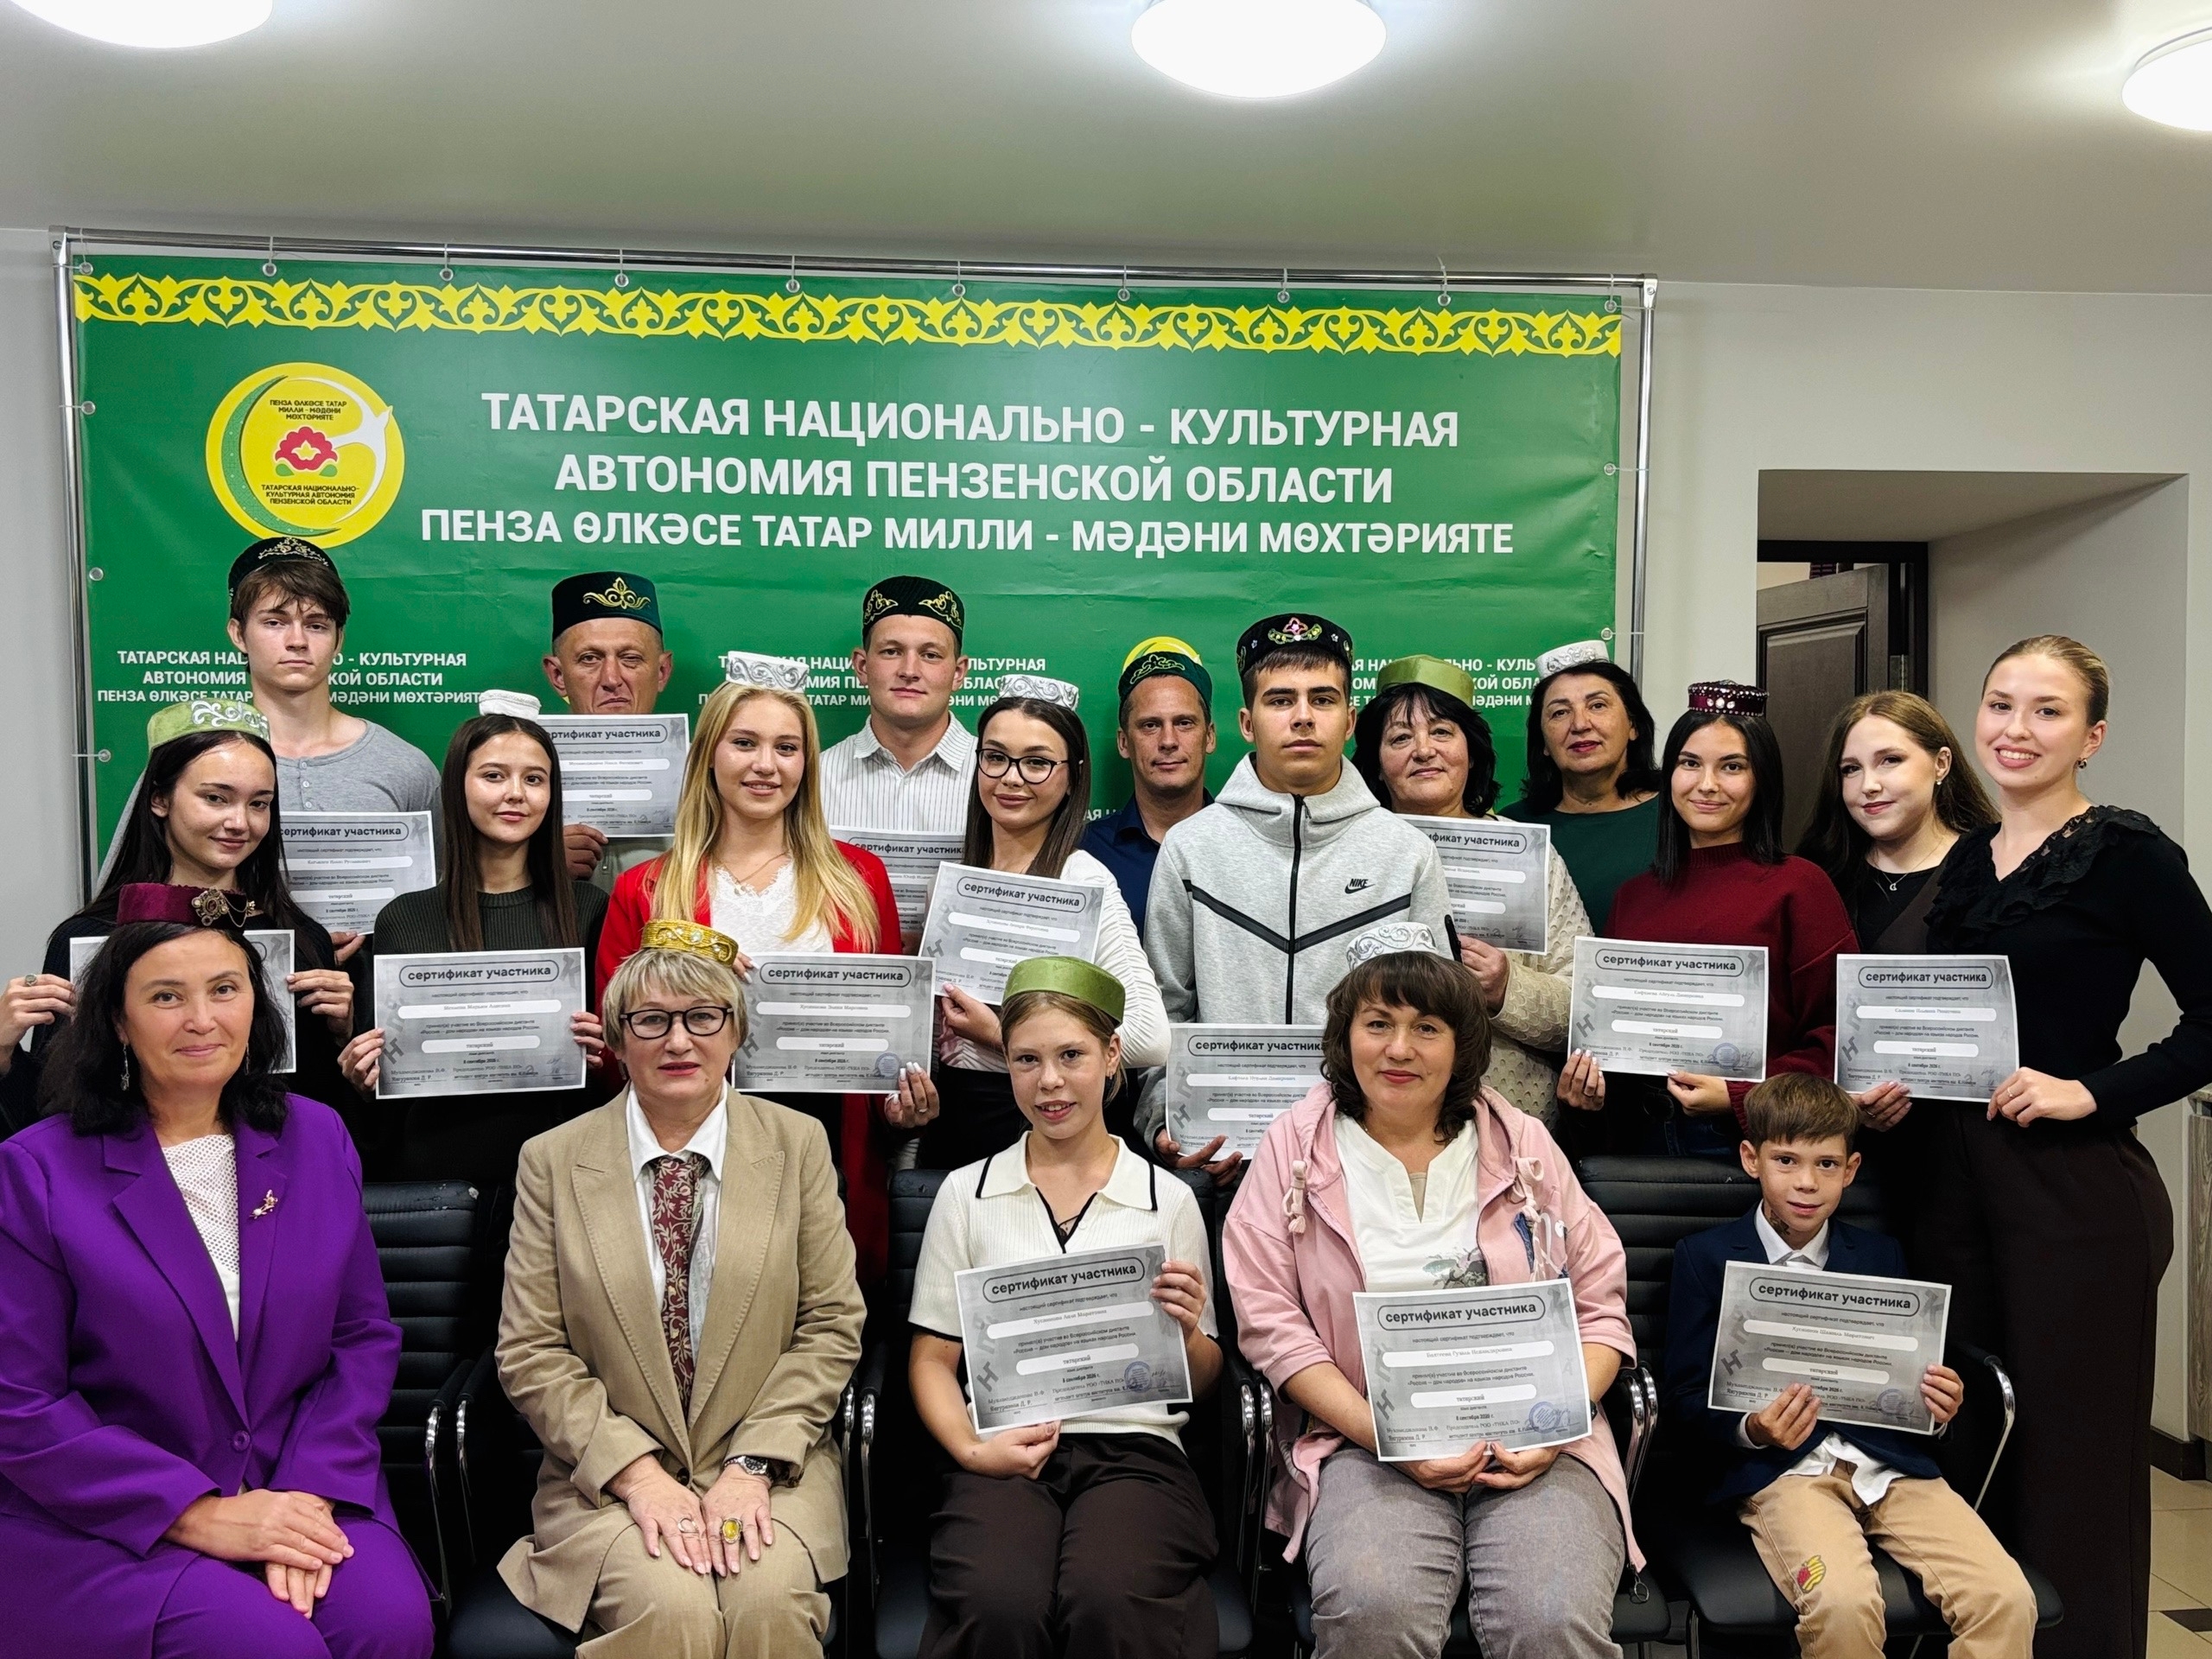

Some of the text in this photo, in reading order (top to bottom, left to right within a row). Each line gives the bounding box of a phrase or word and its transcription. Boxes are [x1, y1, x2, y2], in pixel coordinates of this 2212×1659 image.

[481, 392, 1458, 447] ТАТАРСКАЯ НАЦИОНАЛЬНО - КУЛЬТУРНАЯ
[554, 454, 1393, 504] АВТОНОМИЯ ПЕНЗЕНСКОЙ ОБЛАСТИ
[422, 508, 563, 543] ПЕНЗА
[574, 511, 741, 546] ӨЛКӘСЕ
[752, 514, 873, 549] ТАТАР
[885, 518, 1033, 550] МИЛЛИ
[1072, 520, 1249, 559] МӘДӘНИ
[1260, 521, 1514, 555] МӨХТӘРИЯТЕ
[118, 651, 211, 664] ТАТАРСКАЯ
[359, 653, 467, 666] КУЛЬТУРНАЯ
[968, 658, 1046, 671] ЛЬТУРНАЯ
[143, 671, 246, 684] АВТОНОМИЯ
[365, 672, 442, 686] ОБЛАСТИ
[958, 677, 1001, 690] БЛАС
[1502, 677, 1540, 690] ОБЛА
[98, 690, 146, 702] ПЕНЗА
[394, 692, 482, 703] МӨХТӘРИЯТ
[809, 695, 847, 705] ТАТАР
[1472, 695, 1524, 708] ӘДӘНИ
[547, 729, 660, 740] ртификат участника
[344, 827, 401, 837] участника
[1427, 832, 1520, 847] ификат участника
[1350, 878, 1369, 887] NIKE
[964, 882, 1080, 906] сертификат участника
[1603, 955, 1736, 970] сертификат участника
[408, 966, 551, 982] сертификат участника
[768, 968, 903, 981] сертификат участника
[1866, 972, 1986, 984] сертификат участника
[1196, 1040, 1324, 1052] сертификат участник
[992, 1263, 1136, 1295] сертификат участника
[1758, 1284, 1910, 1309] сертификат участника
[1385, 1304, 1536, 1324] сертификат участника
